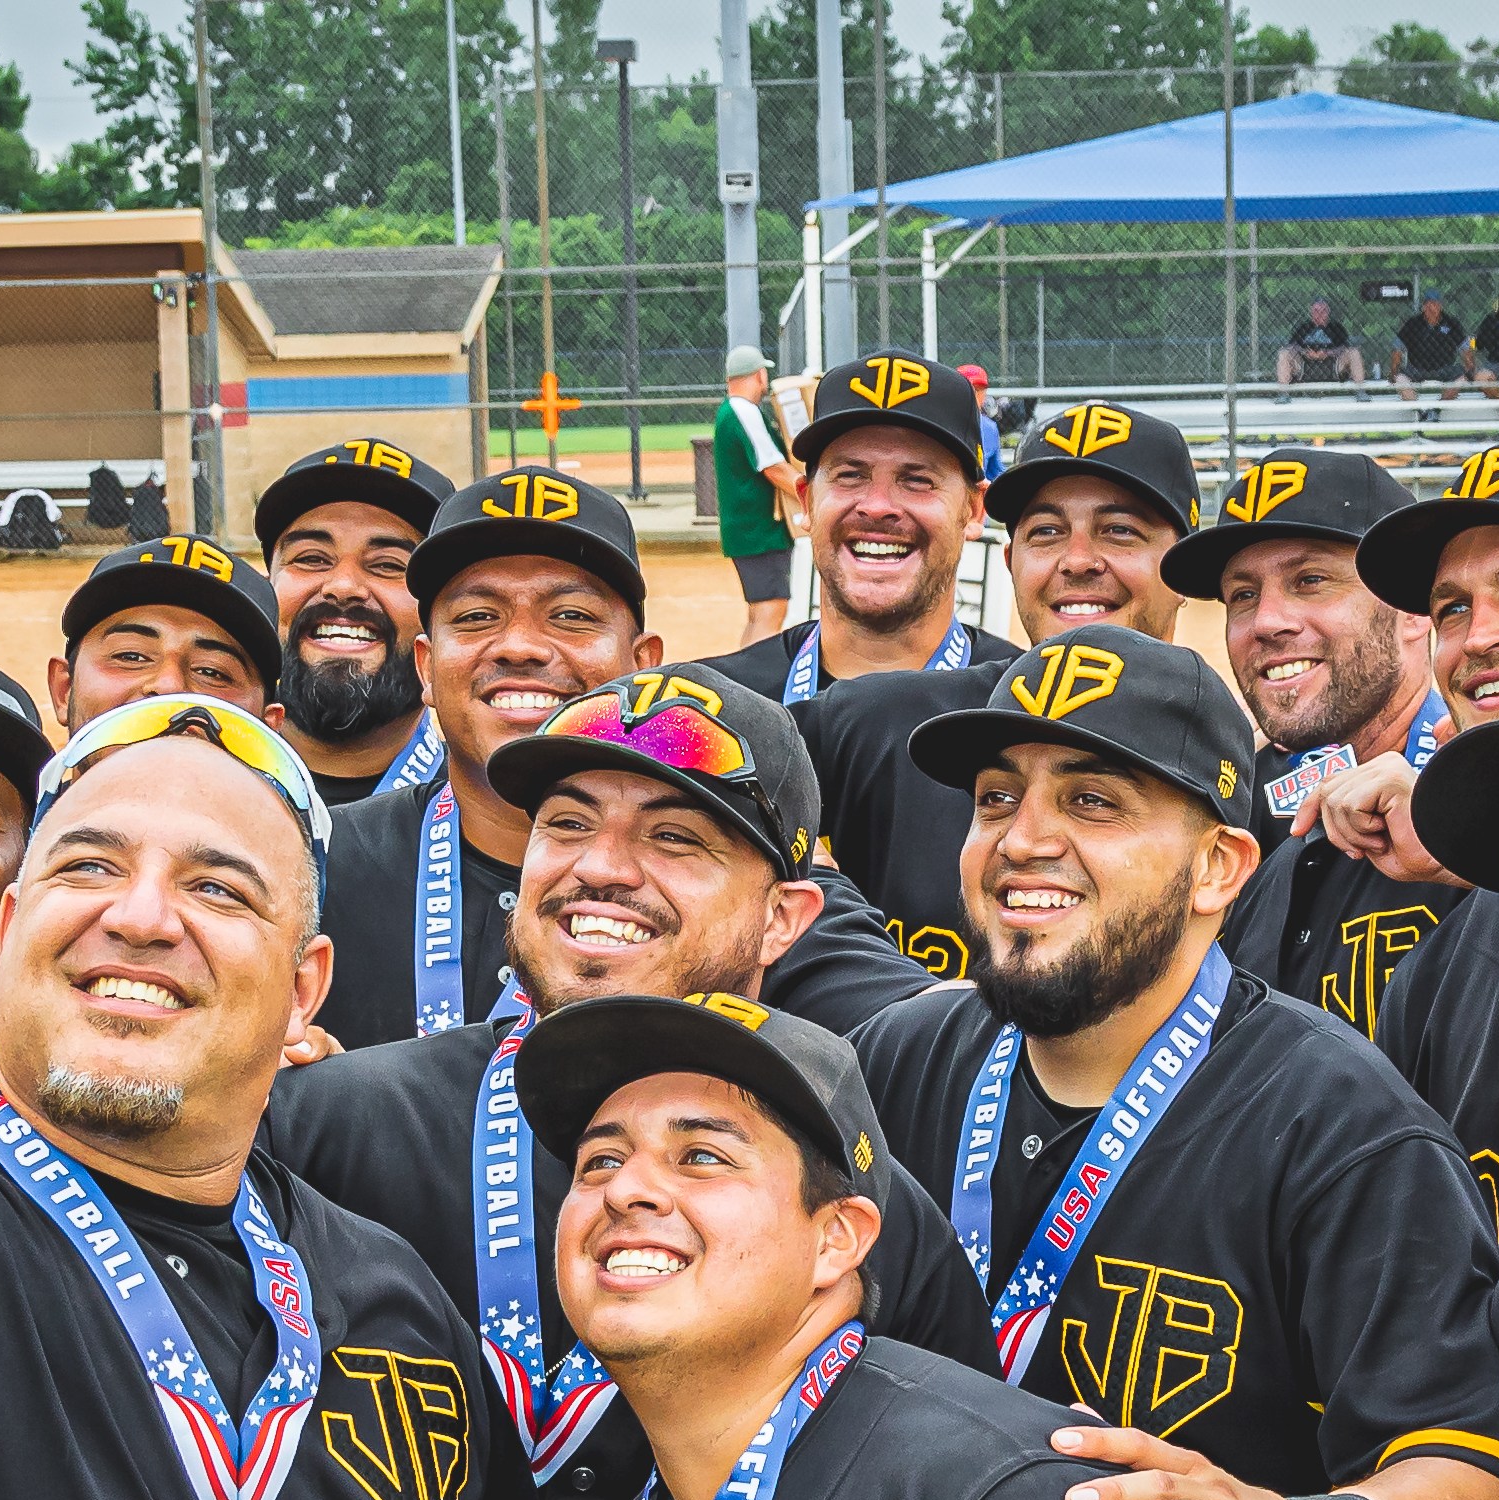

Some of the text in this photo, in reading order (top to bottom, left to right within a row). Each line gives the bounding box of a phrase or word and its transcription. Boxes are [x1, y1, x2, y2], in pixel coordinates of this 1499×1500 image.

[851, 357, 930, 409] JB
[1045, 405, 1132, 457] JB
[482, 474, 578, 521] JB
[1226, 461, 1307, 522] JB
[1011, 643, 1125, 720] JB
[1272, 755, 1350, 801] USA
[424, 820, 452, 968] SOFTBALL
[1044, 992, 1222, 1254] USA SOFTBALL
[485, 1066, 521, 1259] SOFTBALL
[264, 1256, 312, 1339] USA
